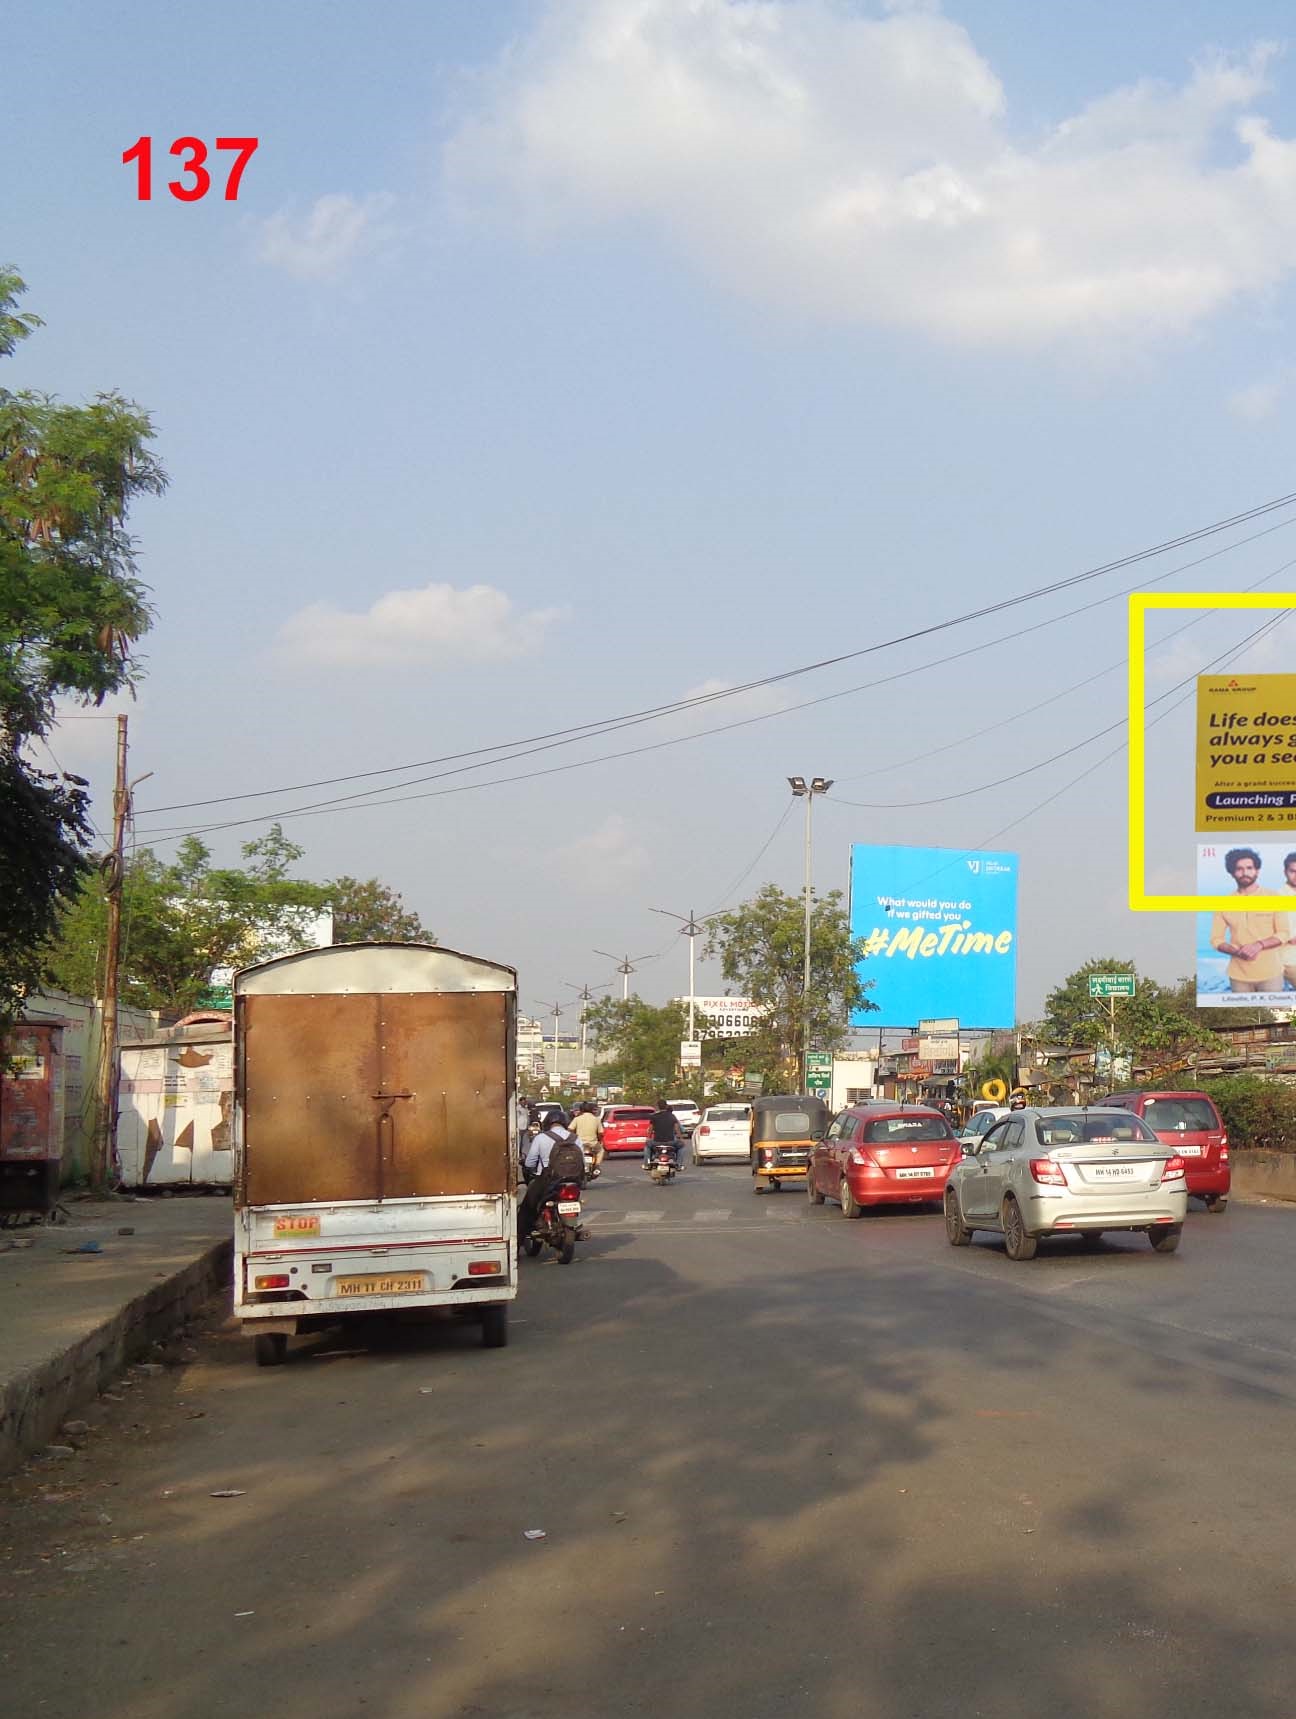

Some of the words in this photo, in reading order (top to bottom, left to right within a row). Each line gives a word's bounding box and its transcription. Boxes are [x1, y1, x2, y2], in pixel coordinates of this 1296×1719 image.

[1209, 713, 1248, 729] Life
[1209, 731, 1284, 748] always
[1210, 753, 1248, 768] you
[1253, 753, 1266, 764] a
[1244, 780, 1267, 788] grand
[1215, 794, 1284, 806] Launching
[1206, 814, 1255, 822] Premium
[1257, 814, 1264, 822] 2
[1277, 813, 1285, 821] 3
[967, 860, 980, 874] VJ
[877, 896, 905, 908] What
[907, 898, 937, 908] would
[939, 900, 957, 911] you
[958, 900, 972, 910] do
[896, 910, 910, 919] we
[912, 909, 941, 921] gifted
[943, 912, 961, 922] you
[862, 920, 1013, 960] #MeTime
[703, 1000, 728, 1008] PIXEL
[276, 1215, 319, 1231] STOP
[340, 1283, 361, 1294] MH
